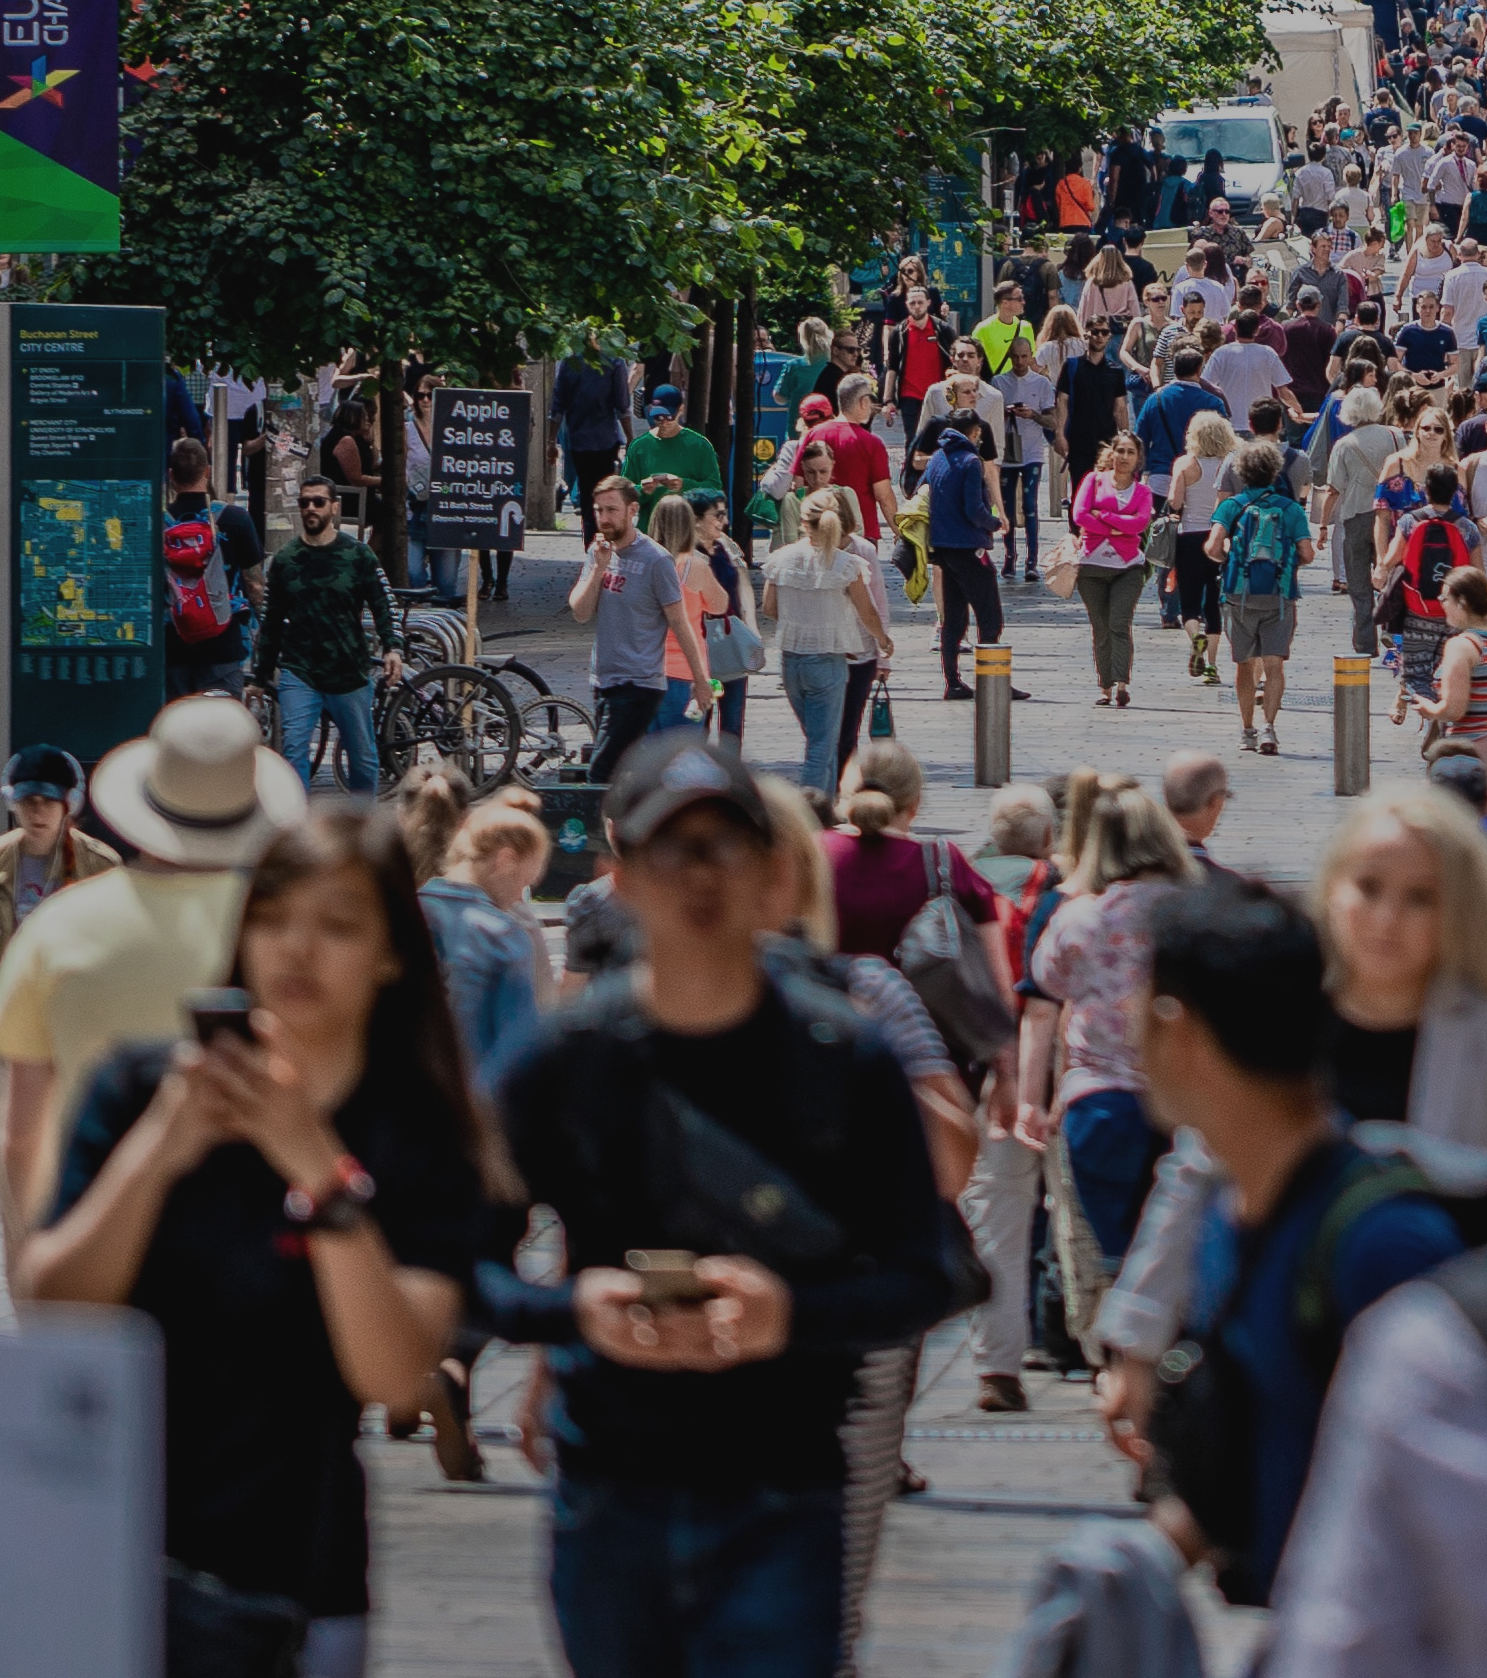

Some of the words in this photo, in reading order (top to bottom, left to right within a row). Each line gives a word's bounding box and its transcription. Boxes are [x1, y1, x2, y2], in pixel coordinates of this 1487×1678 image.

[19, 329, 67, 339] Buchanan
[69, 329, 99, 339] Street
[19, 342, 42, 352] CITY
[43, 342, 85, 352] CENTRE
[451, 400, 510, 422] Apple
[443, 427, 494, 447] Sales
[498, 428, 516, 447] &
[441, 455, 515, 478] Repairs
